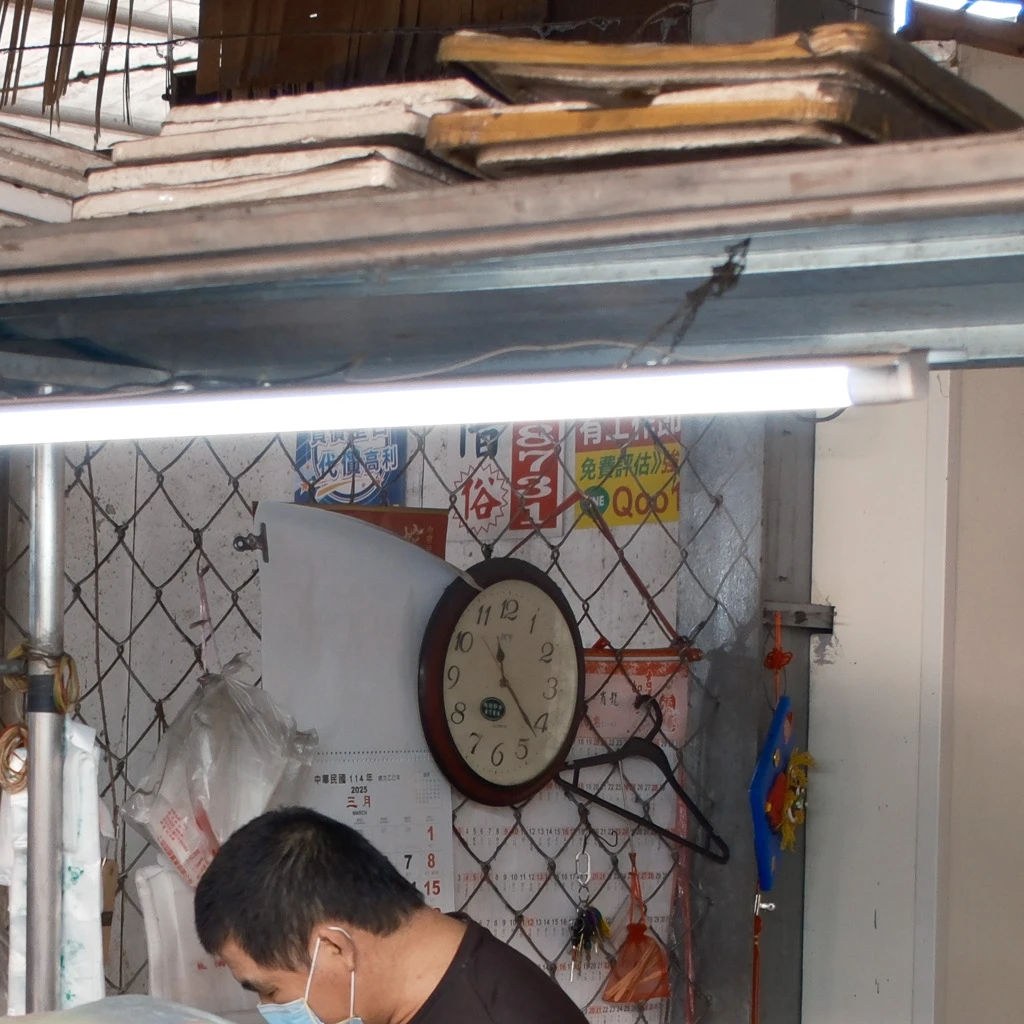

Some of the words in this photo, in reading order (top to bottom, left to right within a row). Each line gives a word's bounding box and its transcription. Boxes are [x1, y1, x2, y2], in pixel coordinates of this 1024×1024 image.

[461, 476, 502, 521] 俗
[476, 604, 492, 627] 11
[500, 599, 519, 621] 12
[529, 613, 538, 635] 1
[454, 631, 474, 653] 10
[538, 642, 554, 664] 2
[447, 665, 460, 690] 9
[542, 676, 559, 701] 3
[450, 702, 466, 725] 8
[533, 712, 549, 733] 4
[469, 731, 483, 755] 7
[515, 738, 530, 760] 5
[491, 742, 504, 767] 6
[351, 786, 368, 794] 2025
[346, 795, 371, 808] 三月
[427, 826, 434, 841] 1
[404, 854, 413, 869] 7
[427, 853, 435, 868] 8
[424, 880, 441, 896] 15
